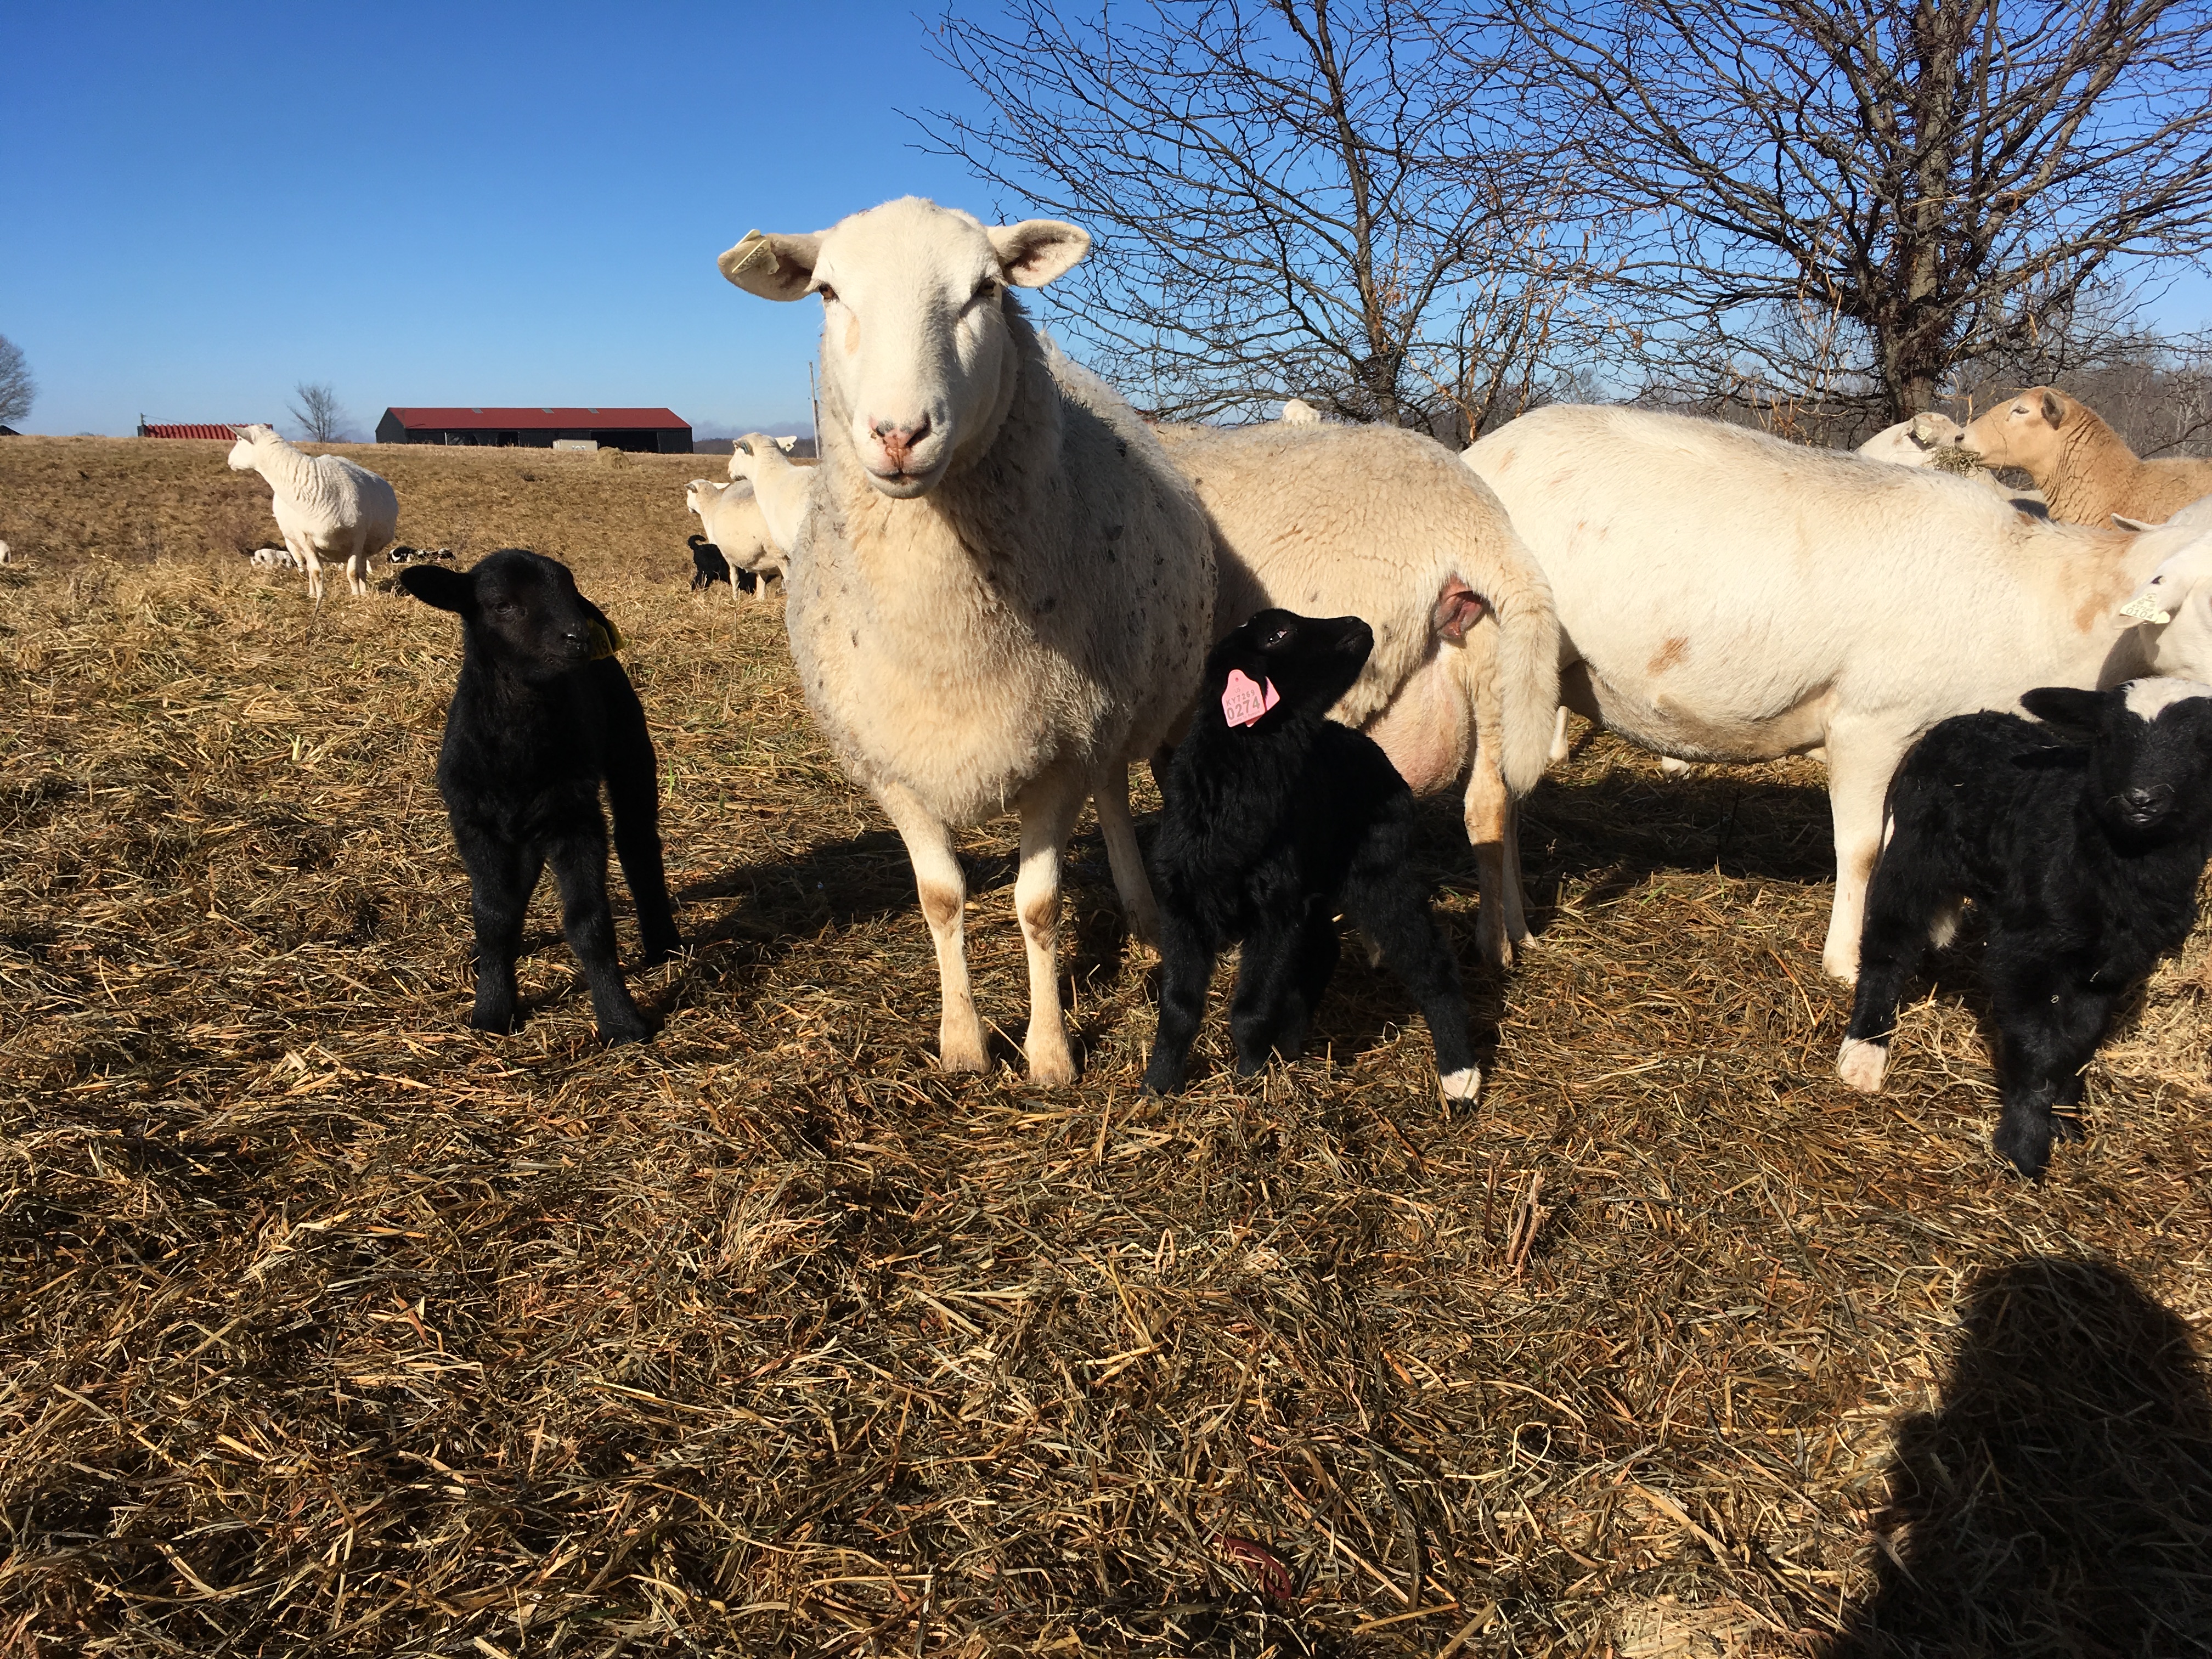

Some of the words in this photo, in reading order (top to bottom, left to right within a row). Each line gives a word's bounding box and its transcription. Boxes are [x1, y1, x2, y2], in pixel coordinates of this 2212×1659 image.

[2126, 607, 2154, 619] 0104
[1226, 689, 1255, 706] KY7269
[1227, 696, 1260, 720] 0274
